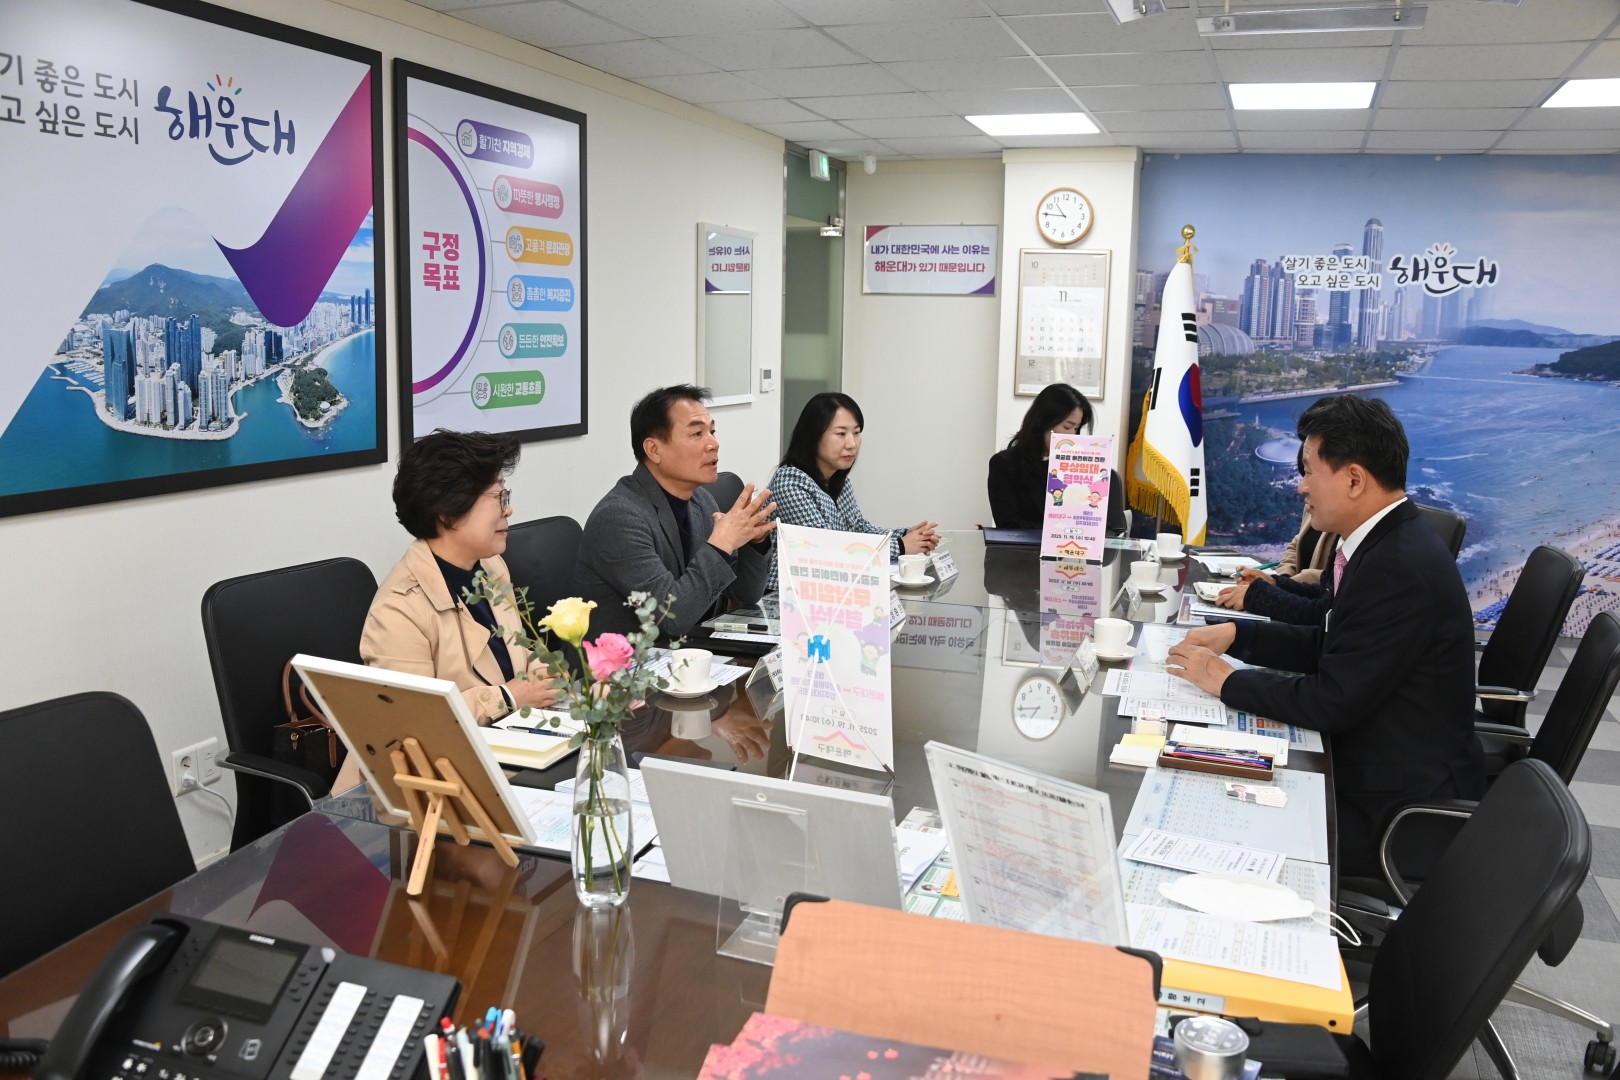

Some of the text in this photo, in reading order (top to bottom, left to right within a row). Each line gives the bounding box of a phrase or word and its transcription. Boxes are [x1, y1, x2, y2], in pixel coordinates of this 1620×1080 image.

[34, 59, 85, 98] 좋은
[94, 72, 139, 107] 도시
[35, 101, 86, 138] 싶은
[94, 111, 139, 145] 도시
[153, 82, 296, 165] 해운대
[478, 134, 532, 160] 활기찬 지역경제
[512, 188, 534, 206] 따뜻한
[422, 231, 460, 262] 구정
[525, 238, 546, 254] 고품격
[870, 243, 990, 256] 내가 대한민국에 사는 이유는
[874, 260, 986, 273] 해운대가 있기 때문입니다
[1031, 261, 1039, 269] 10
[1284, 257, 1368, 271] 살기 좋은 도시
[422, 262, 461, 292] 목표
[1297, 274, 1379, 288] 오고 싶은 도시
[1389, 252, 1497, 294] 해운대
[1058, 290, 1068, 303] 11
[518, 335, 539, 349] 든든한
[492, 381, 542, 398] 시원한 교통흐름
[1058, 461, 1100, 475] 무상임대
[1062, 473, 1094, 485] 협약식
